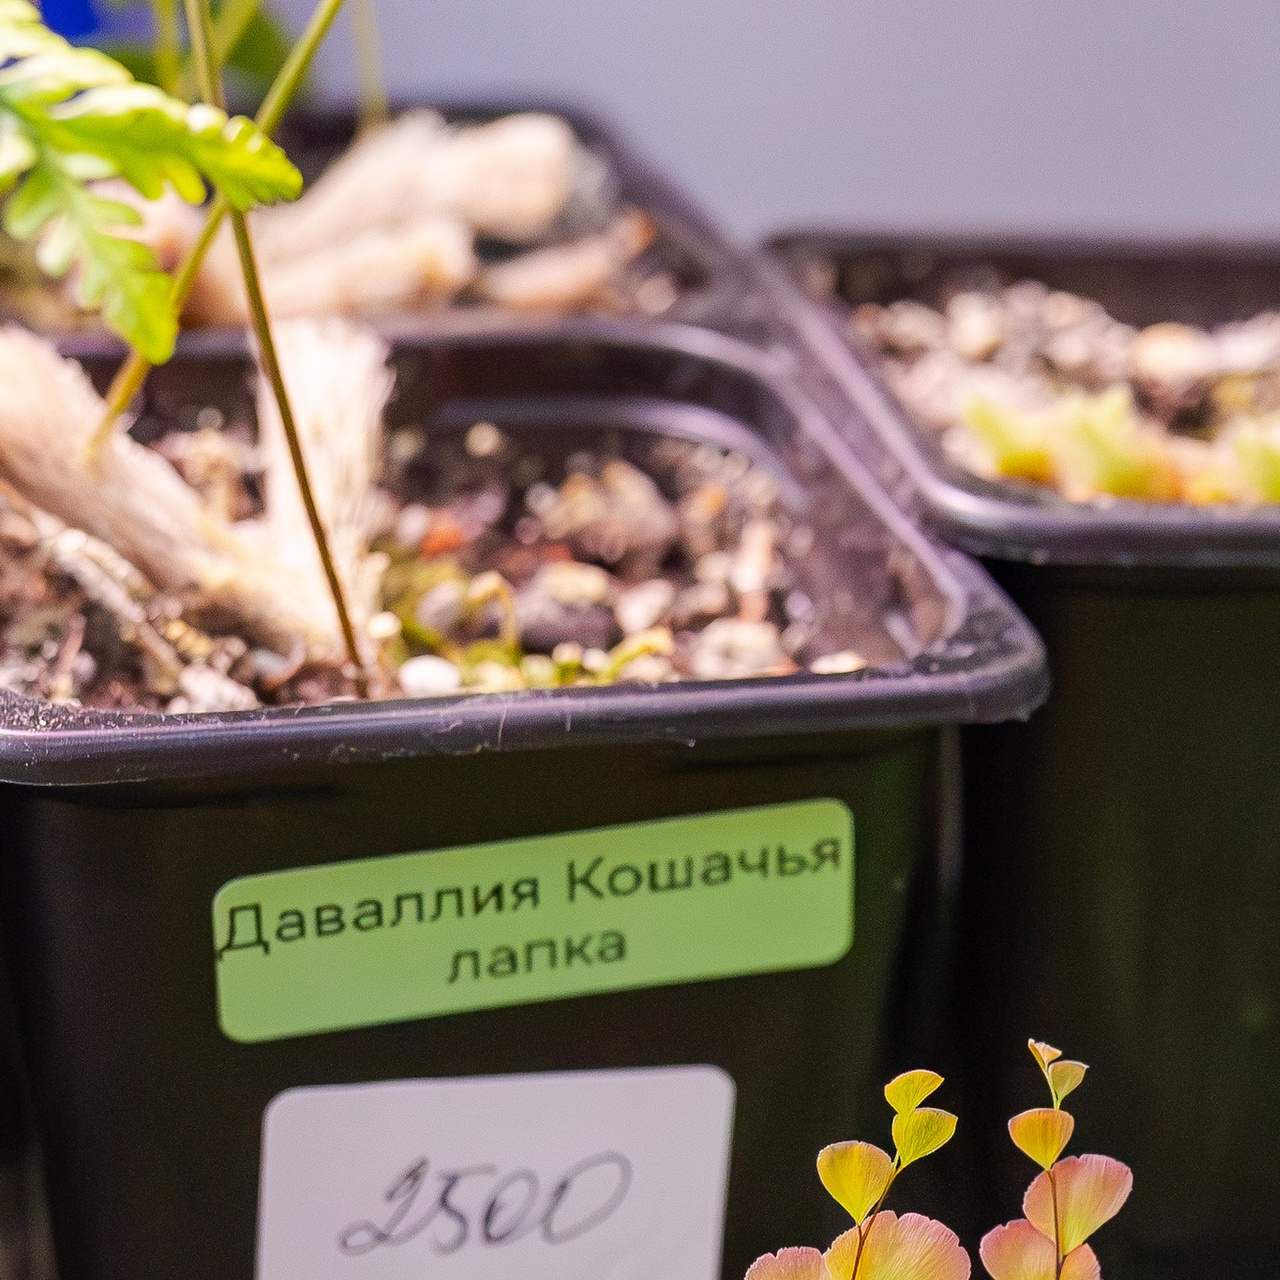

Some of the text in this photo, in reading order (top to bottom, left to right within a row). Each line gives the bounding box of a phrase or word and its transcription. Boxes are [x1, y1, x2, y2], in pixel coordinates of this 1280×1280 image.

[215, 836, 842, 961] Даваллия Кошачья
[445, 927, 629, 985] лапка
[339, 1149, 634, 1256] 2500
